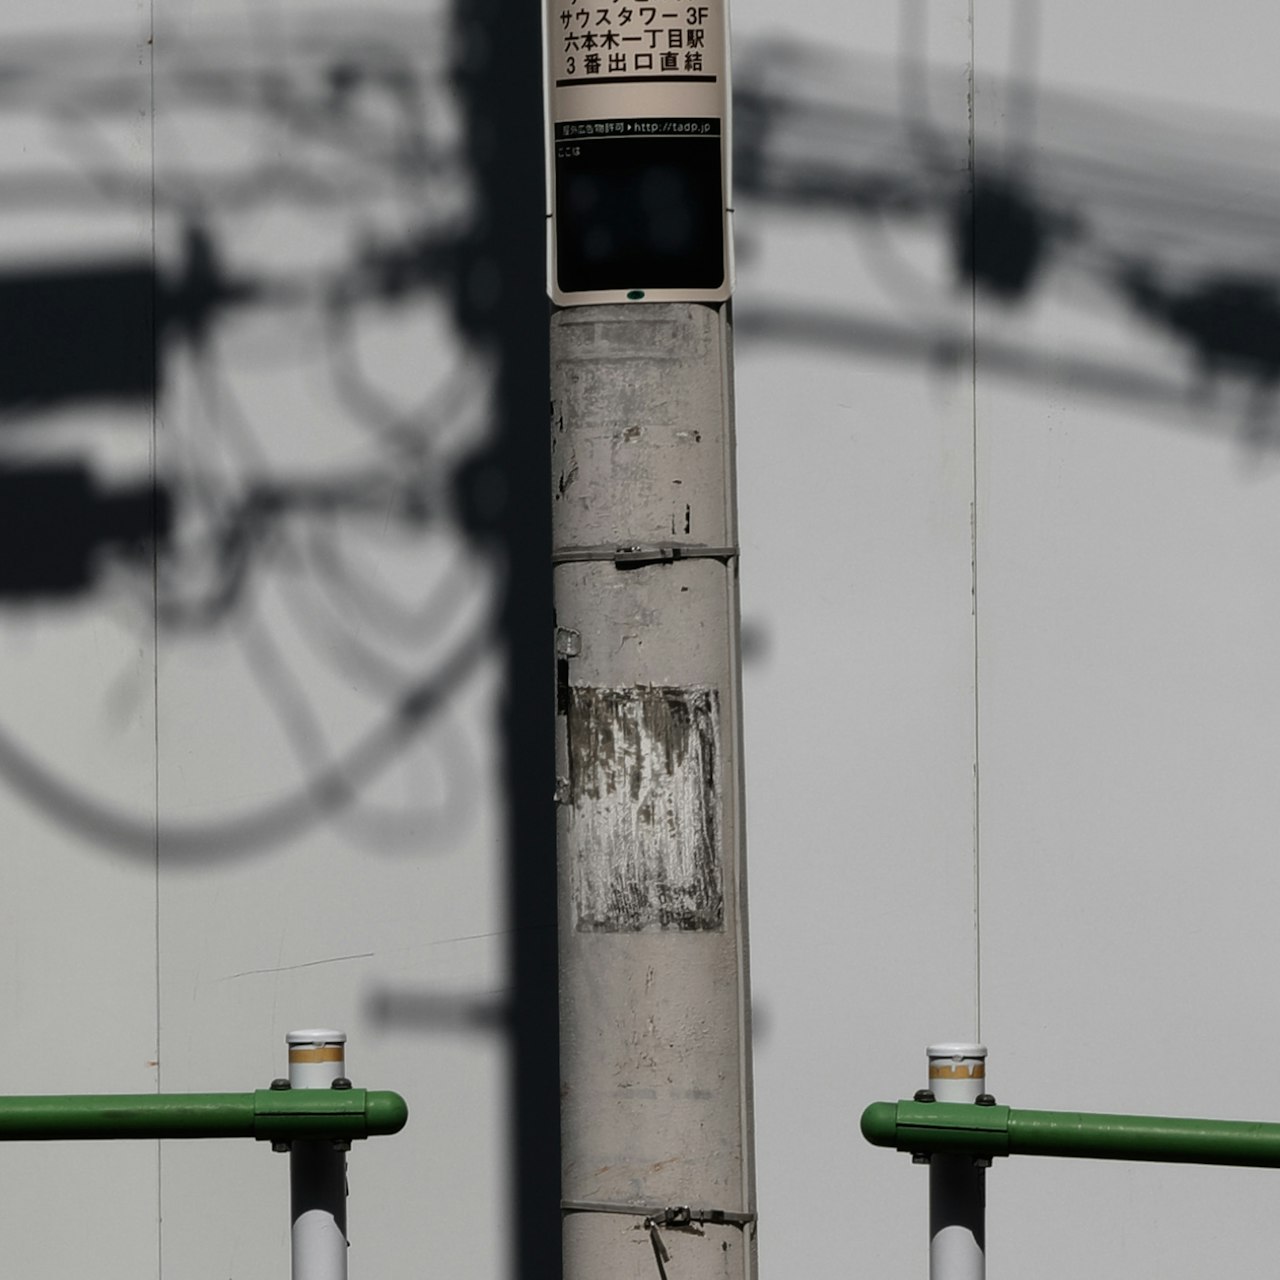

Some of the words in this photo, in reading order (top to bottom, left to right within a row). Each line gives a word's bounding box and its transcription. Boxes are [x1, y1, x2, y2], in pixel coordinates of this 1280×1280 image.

[564, 29, 705, 52] 六本木一丁目駅
[634, 122, 711, 134] http://tadp.jp
